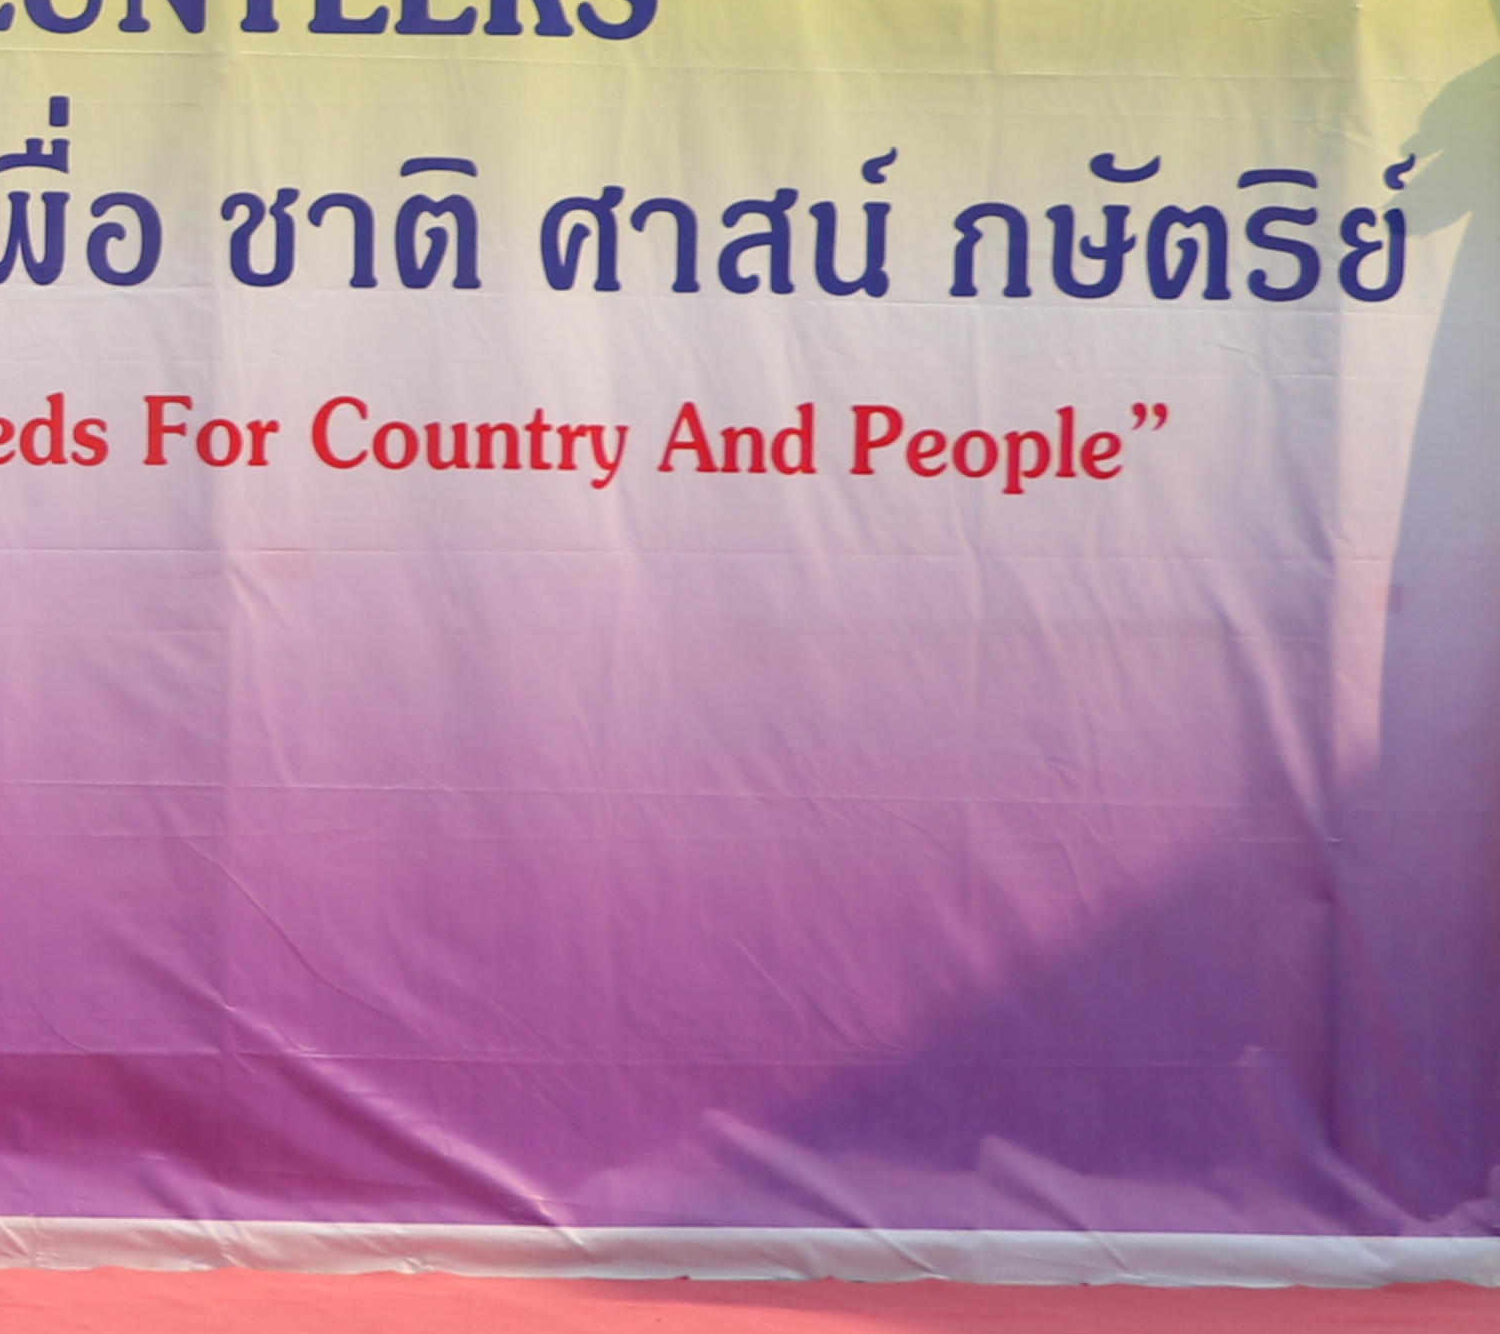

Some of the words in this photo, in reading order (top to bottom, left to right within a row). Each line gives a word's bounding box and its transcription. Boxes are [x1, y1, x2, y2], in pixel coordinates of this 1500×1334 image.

[221, 156, 482, 291] ชาติ
[540, 148, 899, 299] ศาสน์
[949, 152, 1417, 303] กษัตริย์
[143, 394, 281, 469] For
[311, 395, 630, 491] Country
[657, 401, 818, 477] And
